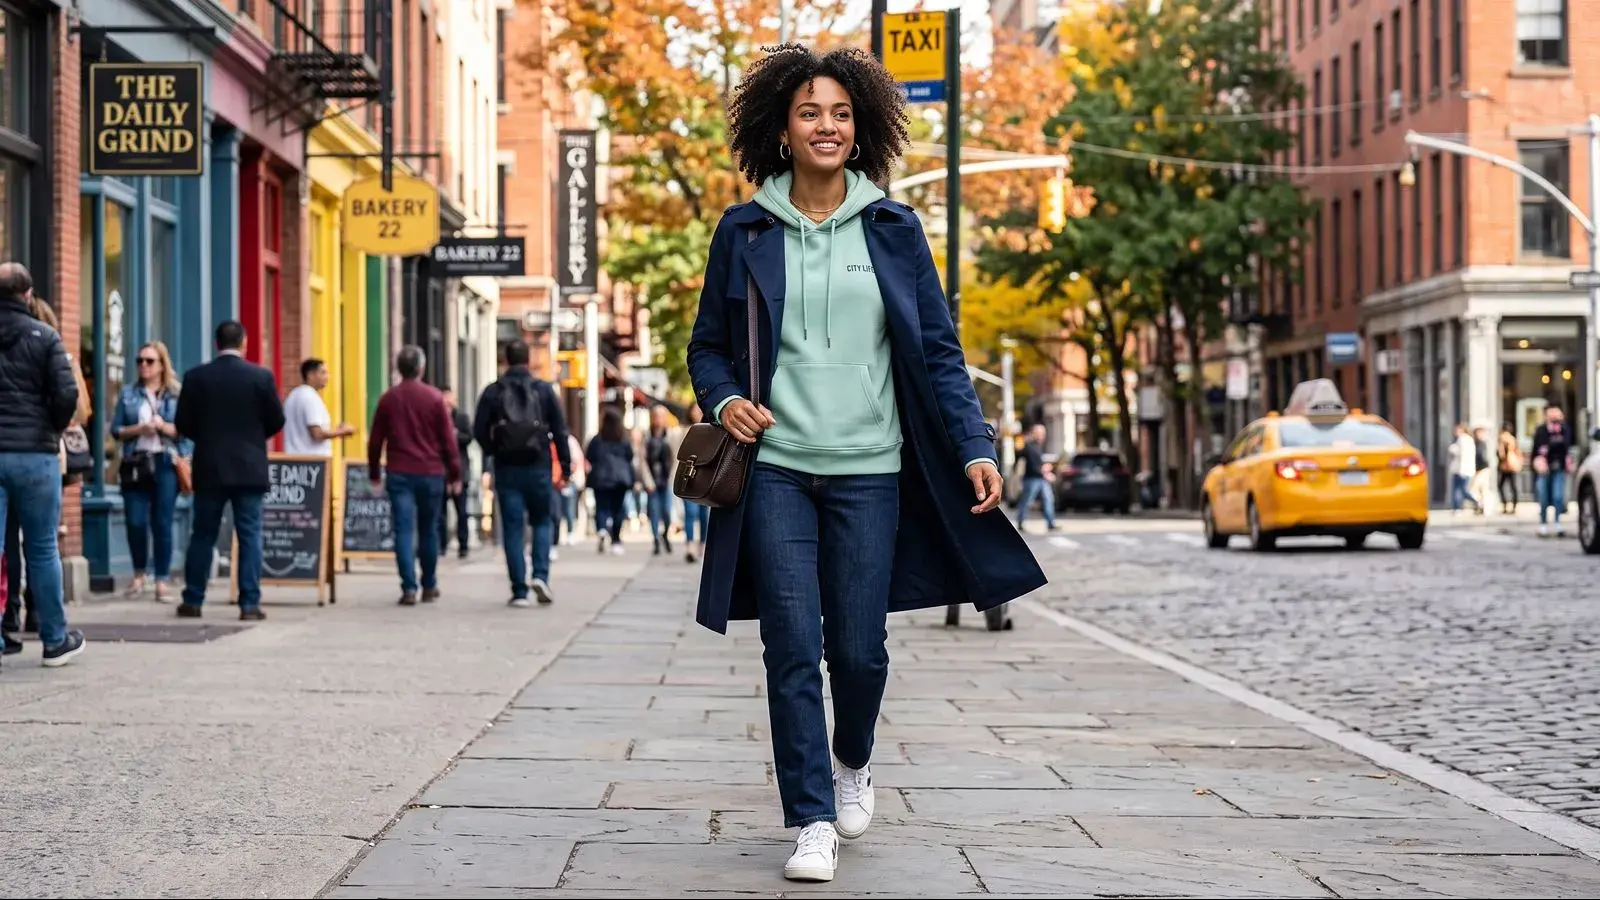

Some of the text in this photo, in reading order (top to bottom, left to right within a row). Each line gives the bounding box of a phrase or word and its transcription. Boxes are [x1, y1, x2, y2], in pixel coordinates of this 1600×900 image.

[889, 28, 940, 53] TAXI
[115, 75, 176, 99] THE
[103, 102, 190, 126] DAILY
[98, 129, 194, 153] GRIND
[352, 199, 428, 217] BAKERY
[566, 147, 588, 284] GALLERY
[378, 220, 402, 238] 22
[435, 244, 521, 262] BAKERY 22
[846, 264, 862, 273] CITY
[281, 464, 321, 489] DAILY
